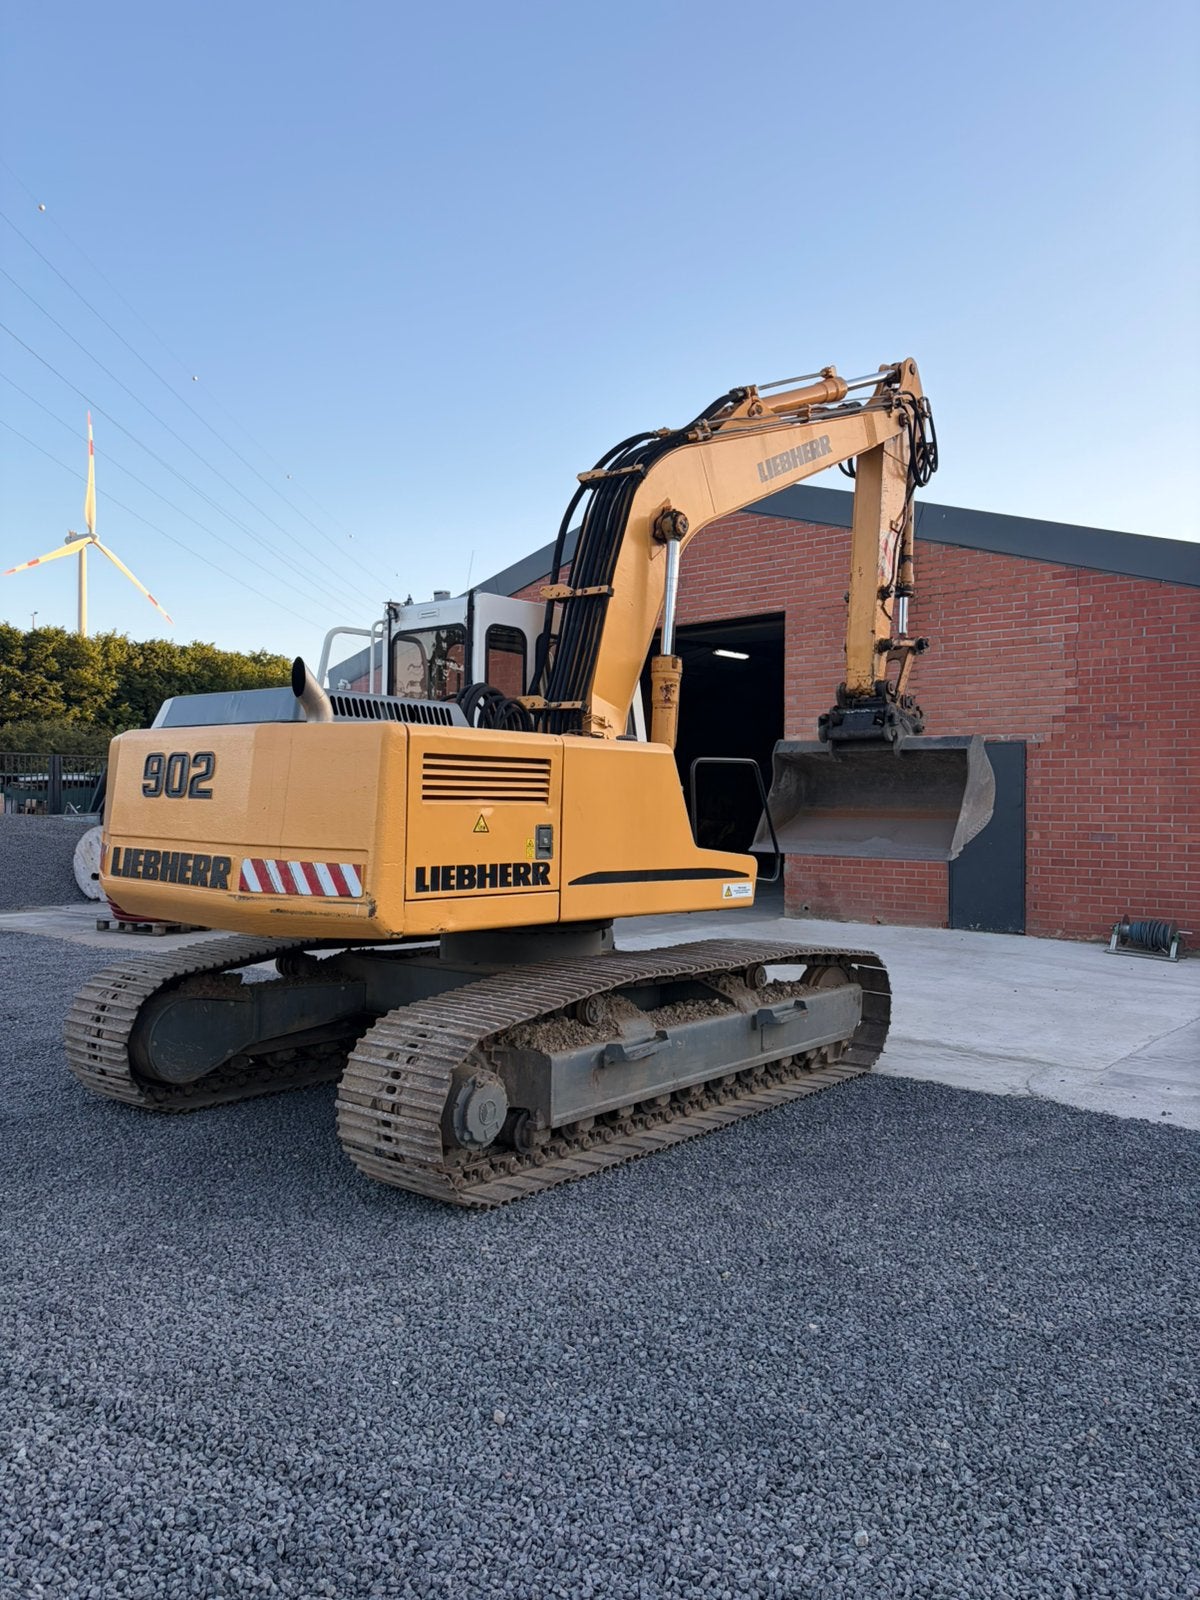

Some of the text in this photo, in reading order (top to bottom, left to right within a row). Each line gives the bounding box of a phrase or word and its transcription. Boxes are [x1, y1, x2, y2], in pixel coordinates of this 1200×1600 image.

[757, 435, 832, 482] LIEBHERR
[142, 751, 215, 799] 902
[110, 847, 232, 890] LIEBHERR
[415, 862, 551, 893] LIEBHERR
